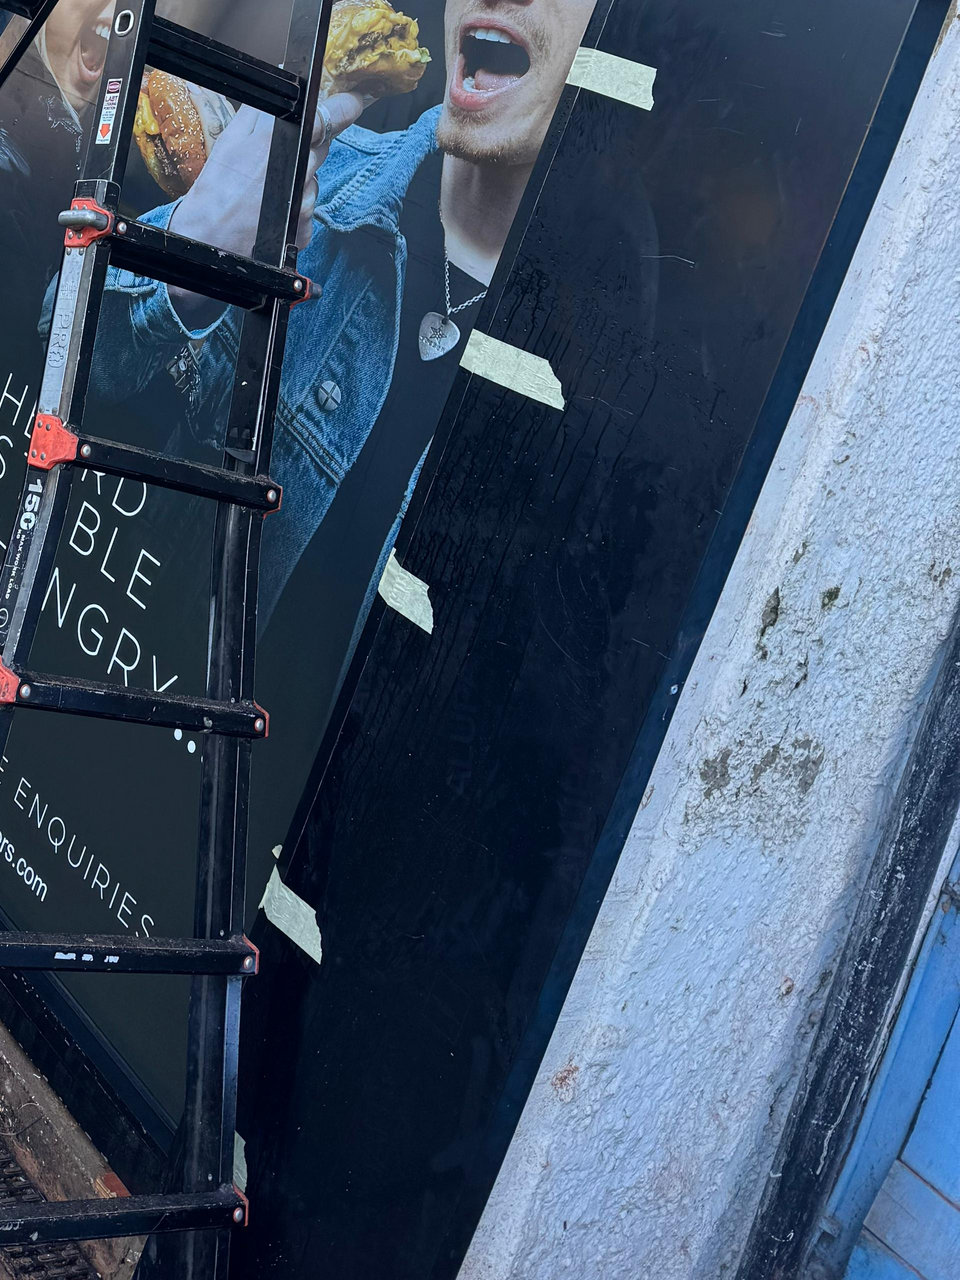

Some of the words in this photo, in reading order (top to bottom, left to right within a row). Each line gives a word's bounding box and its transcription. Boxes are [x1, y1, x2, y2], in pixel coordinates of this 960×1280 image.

[20, 478, 43, 530] 150
[5, 578, 14, 600] LOAD
[13, 777, 155, 937] ENQUIRIES
